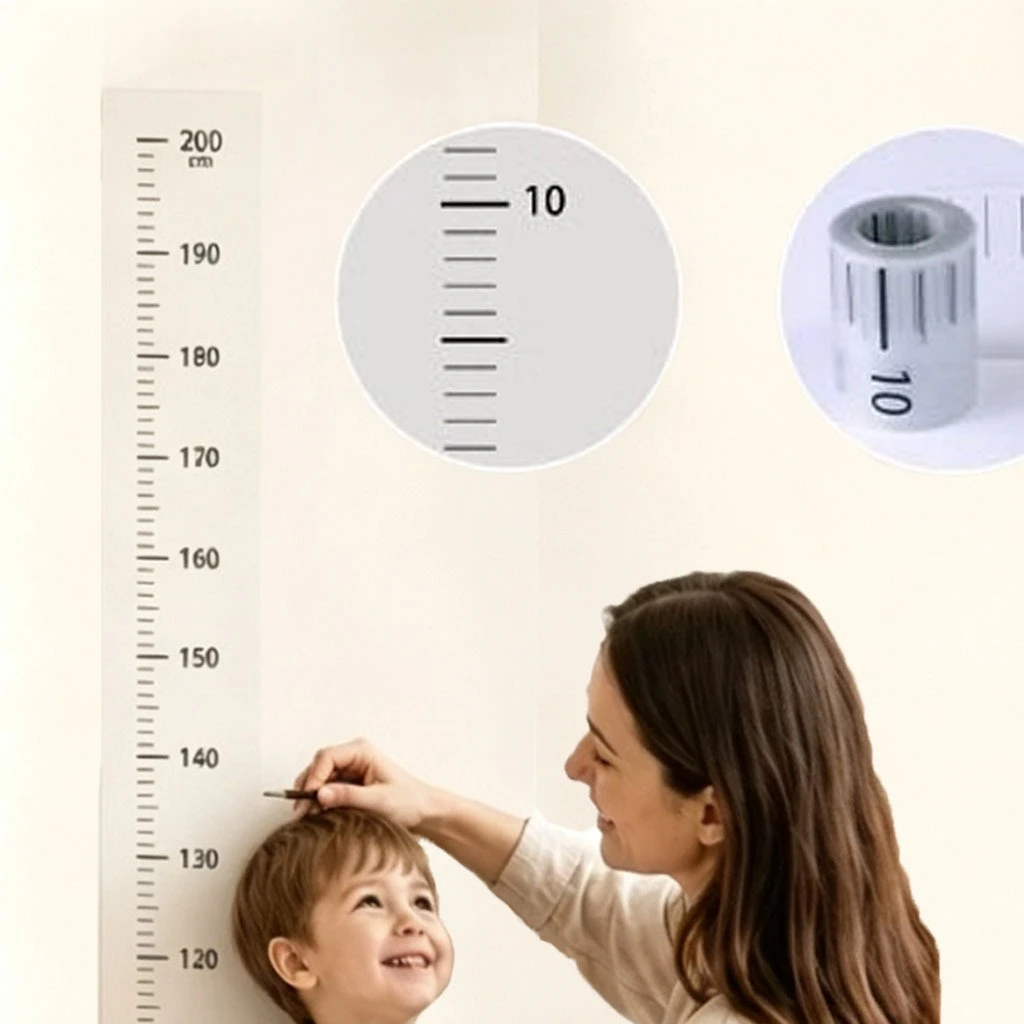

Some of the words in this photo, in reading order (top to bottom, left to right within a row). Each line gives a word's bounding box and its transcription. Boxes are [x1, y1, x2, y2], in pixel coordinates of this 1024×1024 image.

[180, 129, 223, 153] 200
[525, 184, 566, 217] 10
[180, 242, 221, 266] 190
[180, 345, 220, 368] 180
[871, 370, 913, 416] 10
[180, 445, 220, 469] 170
[179, 547, 220, 570] 160
[179, 646, 220, 669] 150
[180, 747, 219, 769] 140
[180, 848, 220, 870] 130
[180, 947, 219, 971] 120
